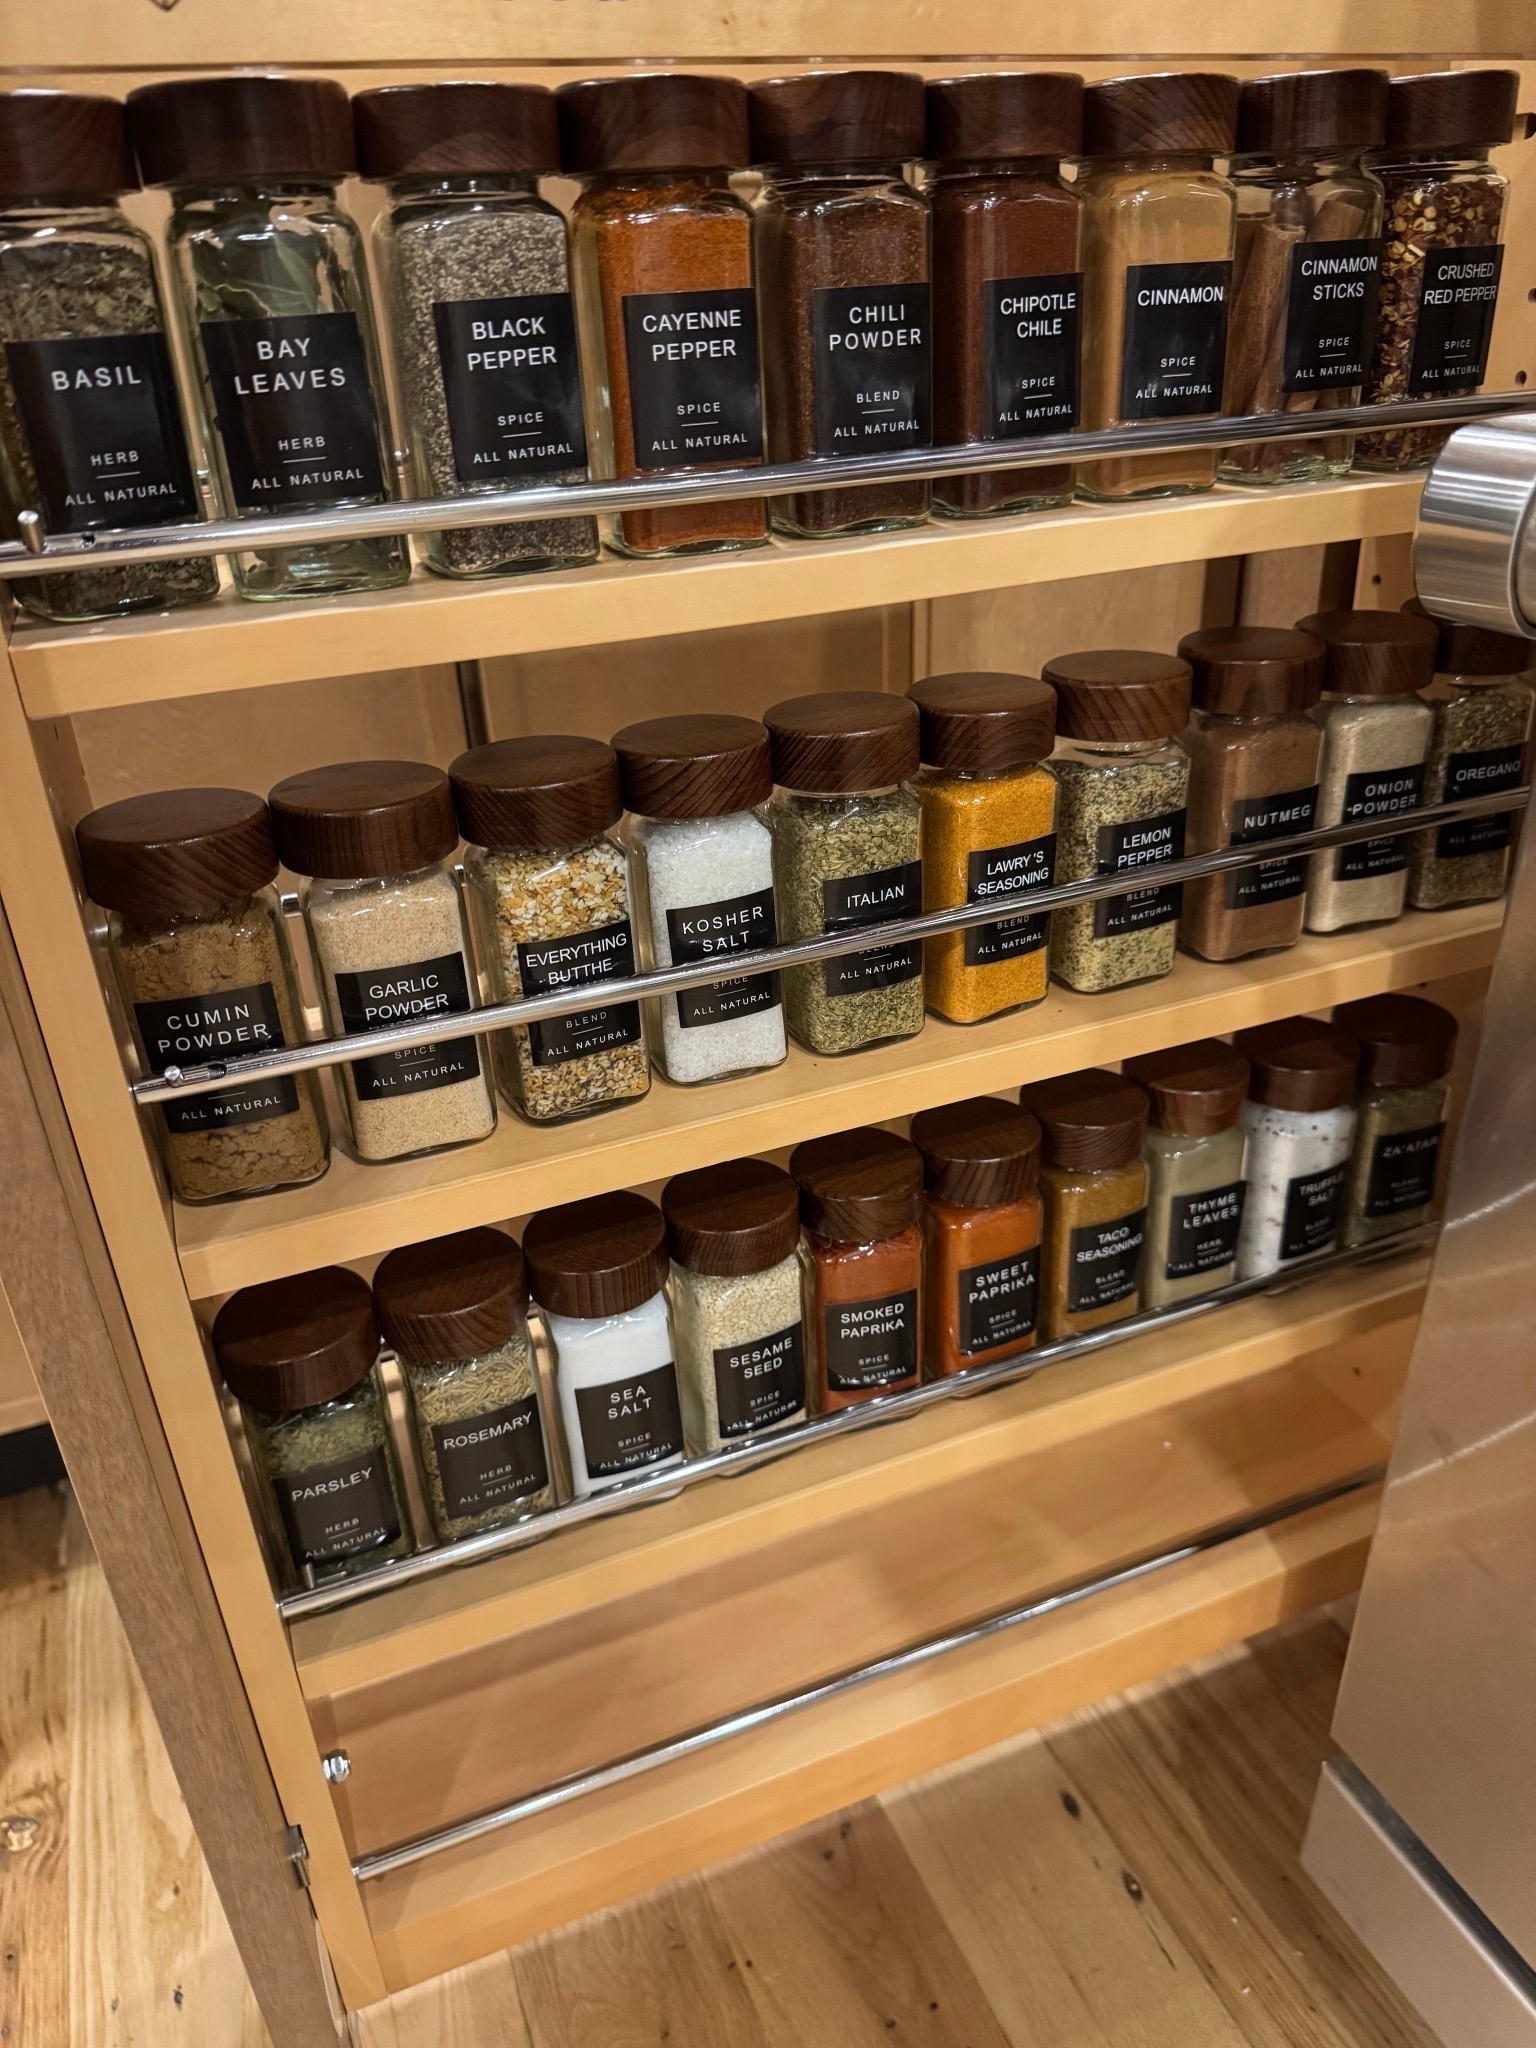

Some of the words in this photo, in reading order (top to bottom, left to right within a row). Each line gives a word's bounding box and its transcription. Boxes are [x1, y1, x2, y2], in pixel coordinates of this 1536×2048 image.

[1301, 256, 1377, 276] CINNAMON
[1438, 263, 1494, 281] CRUSHED
[1137, 286, 1223, 307] CINNAMON
[1313, 282, 1364, 300] STICKS
[1424, 289, 1453, 305] RED
[1455, 285, 1496, 303] PEPPER
[849, 304, 905, 324] CHILI
[1000, 293, 1076, 315] CHIPOTLE
[472, 316, 545, 340] BLACK
[642, 310, 742, 333] CAYENNE
[1017, 318, 1062, 339] CHILE
[256, 337, 310, 361] BAY
[652, 339, 736, 361] PEPPER
[829, 328, 922, 351] POWDER
[1319, 337, 1350, 348] SPICE
[1444, 339, 1471, 350] SPICE
[467, 346, 557, 371] PEPPER
[1161, 356, 1196, 368] SPICE
[51, 365, 142, 390] BASIL
[234, 367, 346, 395] LEAVES
[1296, 368, 1315, 379] ALL
[1320, 364, 1363, 377] NATURAL
[1422, 369, 1439, 379] ALL
[1444, 365, 1479, 377] NATURAL
[1022, 376, 1056, 389] SPICE
[1136, 388, 1158, 399] ALL
[1163, 384, 1212, 397] NATURAL
[857, 390, 900, 404] BLEND
[497, 412, 544, 426] SPICE
[677, 402, 721, 416] SPICE
[999, 411, 1020, 422] ALL
[1026, 404, 1072, 419] NATURAL
[834, 426, 857, 437] ALL
[865, 419, 920, 435] NATURAL
[278, 436, 325, 452] HERB
[652, 440, 678, 451] ALL
[685, 432, 748, 448] NATURAL
[90, 450, 139, 466] HERB
[473, 451, 500, 464] ALL
[508, 442, 573, 460] NATURAL
[251, 476, 281, 490] ALL
[290, 468, 364, 485] NATURAL
[65, 492, 95, 507] ALL
[104, 482, 177, 502] NATURAL
[1456, 761, 1520, 781] OREGANO
[1365, 779, 1413, 796] ONION
[1352, 794, 1416, 815] POWDER
[1245, 804, 1311, 828] NUTMEG
[1123, 827, 1172, 849] LEMON
[1118, 844, 1173, 867] PEPPER
[978, 867, 1048, 894] SEASONING
[1239, 885, 1256, 894] ALL
[1261, 875, 1300, 890] NATURAL
[847, 884, 904, 908] ITALIAN
[1127, 888, 1159, 901] BLEND
[683, 906, 763, 934] KOSHER
[997, 916, 1029, 929] BLEND
[1108, 918, 1126, 926] ALL
[1131, 905, 1173, 921] NATURAL
[526, 933, 627, 967] EVERYTHING
[703, 931, 750, 951] SALT
[978, 944, 996, 954] ALL
[1001, 932, 1042, 949] NATURAL
[840, 971, 859, 980] ALL
[866, 957, 912, 975] NATURAL
[369, 975, 438, 999] GARLIC
[713, 976, 748, 989] SPICE
[365, 993, 449, 1021] POWDER
[694, 1006, 714, 1016] ALL
[721, 992, 770, 1010] NATURAL
[167, 1004, 249, 1030] CUMIN
[566, 1011, 607, 1029] BLEND
[158, 1023, 270, 1053] POWDER
[548, 1046, 569, 1056] ALL
[576, 1029, 628, 1050] NATURAL
[395, 1044, 436, 1059] SPICE
[372, 1077, 397, 1087] ALL
[405, 1062, 464, 1082] NATURAL
[182, 1110, 207, 1120] ALL
[215, 1096, 281, 1115] NATURAL
[1189, 1192, 1237, 1214] THYME
[1183, 1205, 1240, 1229] LEAVES
[1098, 1227, 1130, 1244] TACO
[1077, 1233, 1143, 1263] SEASONING
[976, 1261, 1029, 1287] SWEET
[969, 1274, 1035, 1303] PAPRIKA
[841, 1303, 904, 1323] SMOKED
[989, 1309, 1017, 1323] SPICE
[841, 1319, 904, 1339] PAPRIKA
[972, 1336, 989, 1345] ALL
[993, 1320, 1031, 1339] NATURAL
[730, 1337, 792, 1368] SESAME
[859, 1354, 889, 1365] SPICE
[744, 1357, 782, 1378] SEED
[863, 1366, 906, 1382] NATURAL
[611, 1385, 646, 1403] SEA
[750, 1390, 780, 1406] SPICE
[608, 1397, 651, 1418] SALT
[756, 1400, 797, 1422] NATURAL
[444, 1412, 532, 1450] ROSEMARY
[618, 1432, 651, 1447] SPICE
[600, 1460, 620, 1469] ALL
[625, 1443, 672, 1463] NATURAL
[480, 1465, 512, 1480] HERB
[292, 1467, 372, 1501] PARSLEY
[460, 1494, 480, 1504] ALL
[486, 1474, 536, 1496] NATURAL
[326, 1518, 359, 1533] HERB
[306, 1548, 326, 1558] ALL
[333, 1527, 386, 1550] NATURAL
